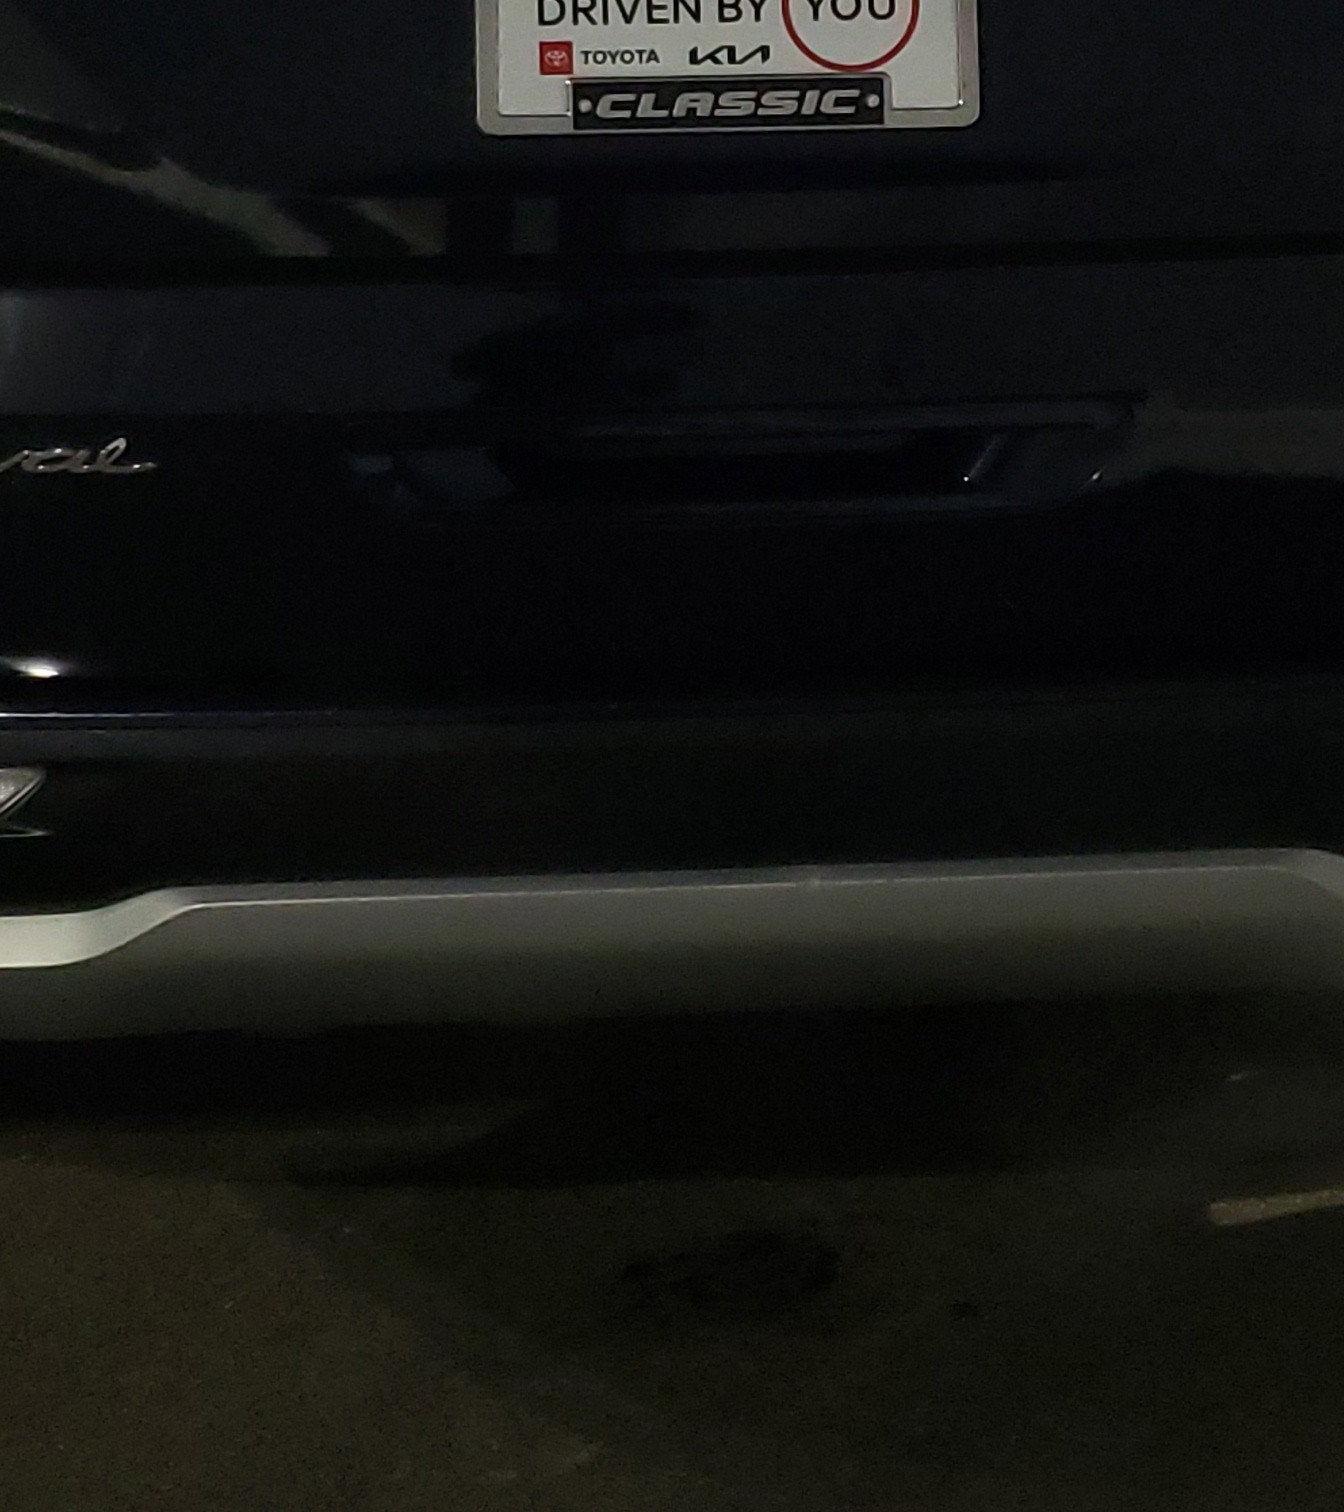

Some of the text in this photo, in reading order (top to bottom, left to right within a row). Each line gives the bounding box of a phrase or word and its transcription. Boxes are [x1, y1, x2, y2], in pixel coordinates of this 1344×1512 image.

[580, 48, 660, 65] TOYOTA
[689, 45, 771, 65] KIA
[595, 89, 861, 119] CLASSIC
